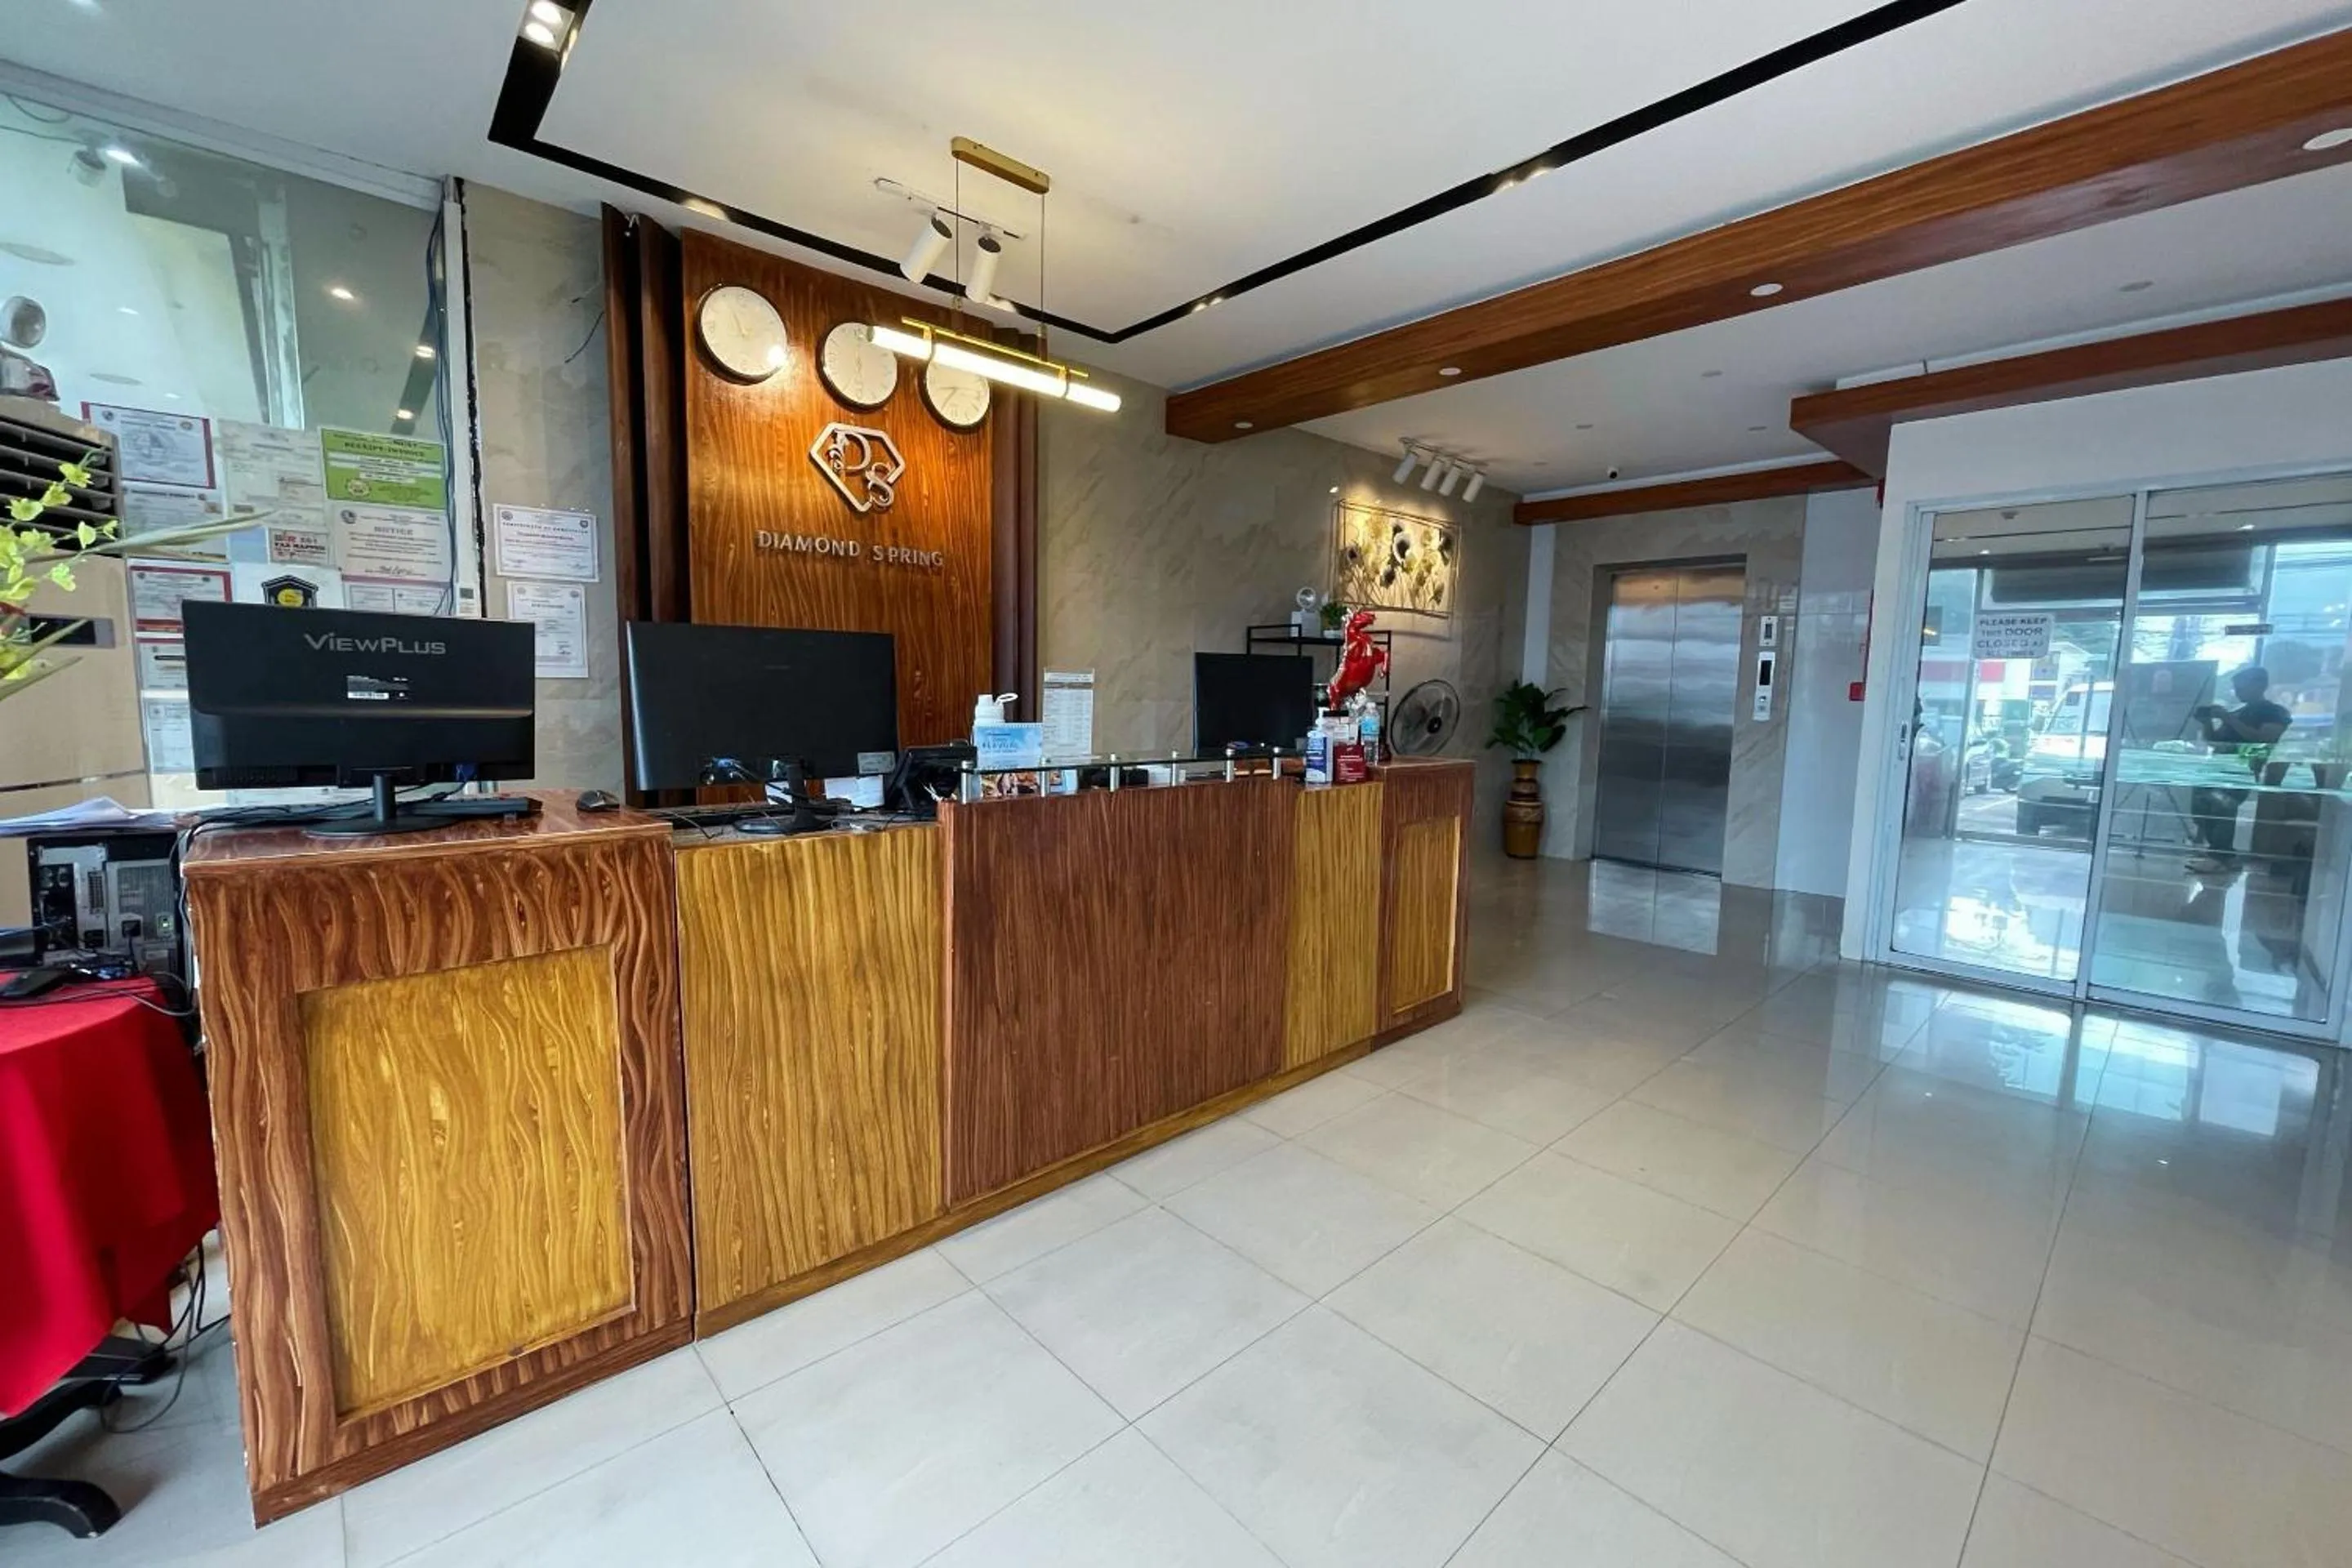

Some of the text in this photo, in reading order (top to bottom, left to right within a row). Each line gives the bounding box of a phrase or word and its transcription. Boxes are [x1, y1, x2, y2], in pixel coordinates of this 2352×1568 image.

[757, 530, 944, 566] DIAMOND SPRING
[1979, 617, 2047, 626] PLEASE KEEP
[2005, 626, 2043, 636] DOOR
[1976, 639, 2029, 648] CLOSED
